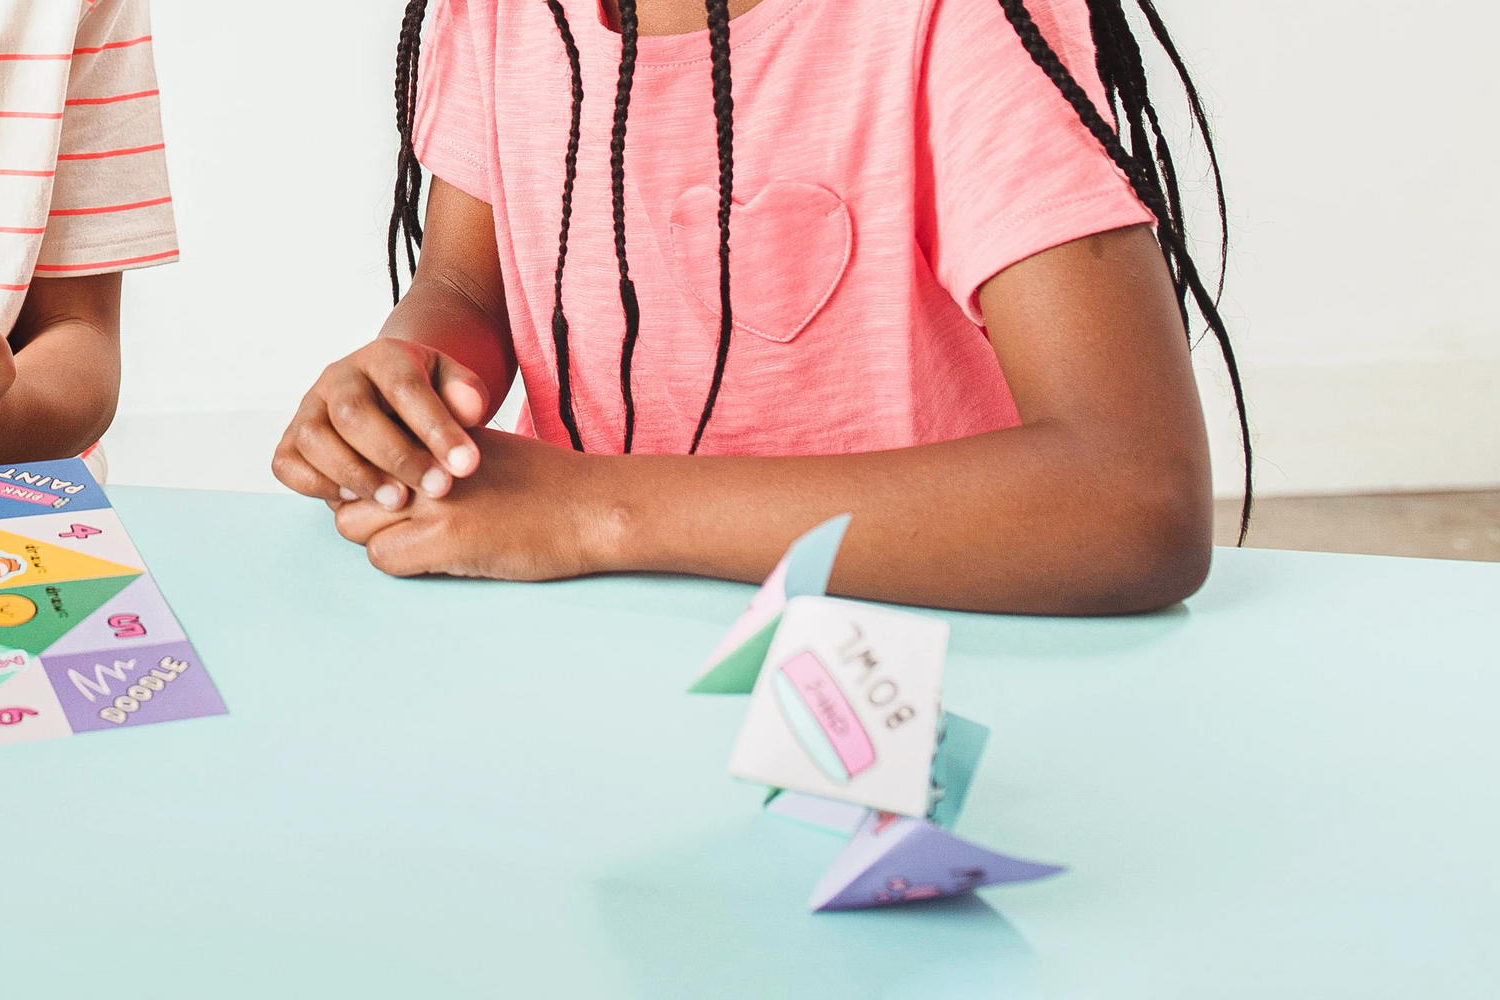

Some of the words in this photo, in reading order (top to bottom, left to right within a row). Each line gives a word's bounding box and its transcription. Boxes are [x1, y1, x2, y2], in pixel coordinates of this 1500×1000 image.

[0, 485, 44, 502] PINK
[58, 523, 102, 540] 4
[107, 613, 147, 639] 5
[836, 622, 916, 730] BOWL
[99, 656, 190, 724] DOODLE
